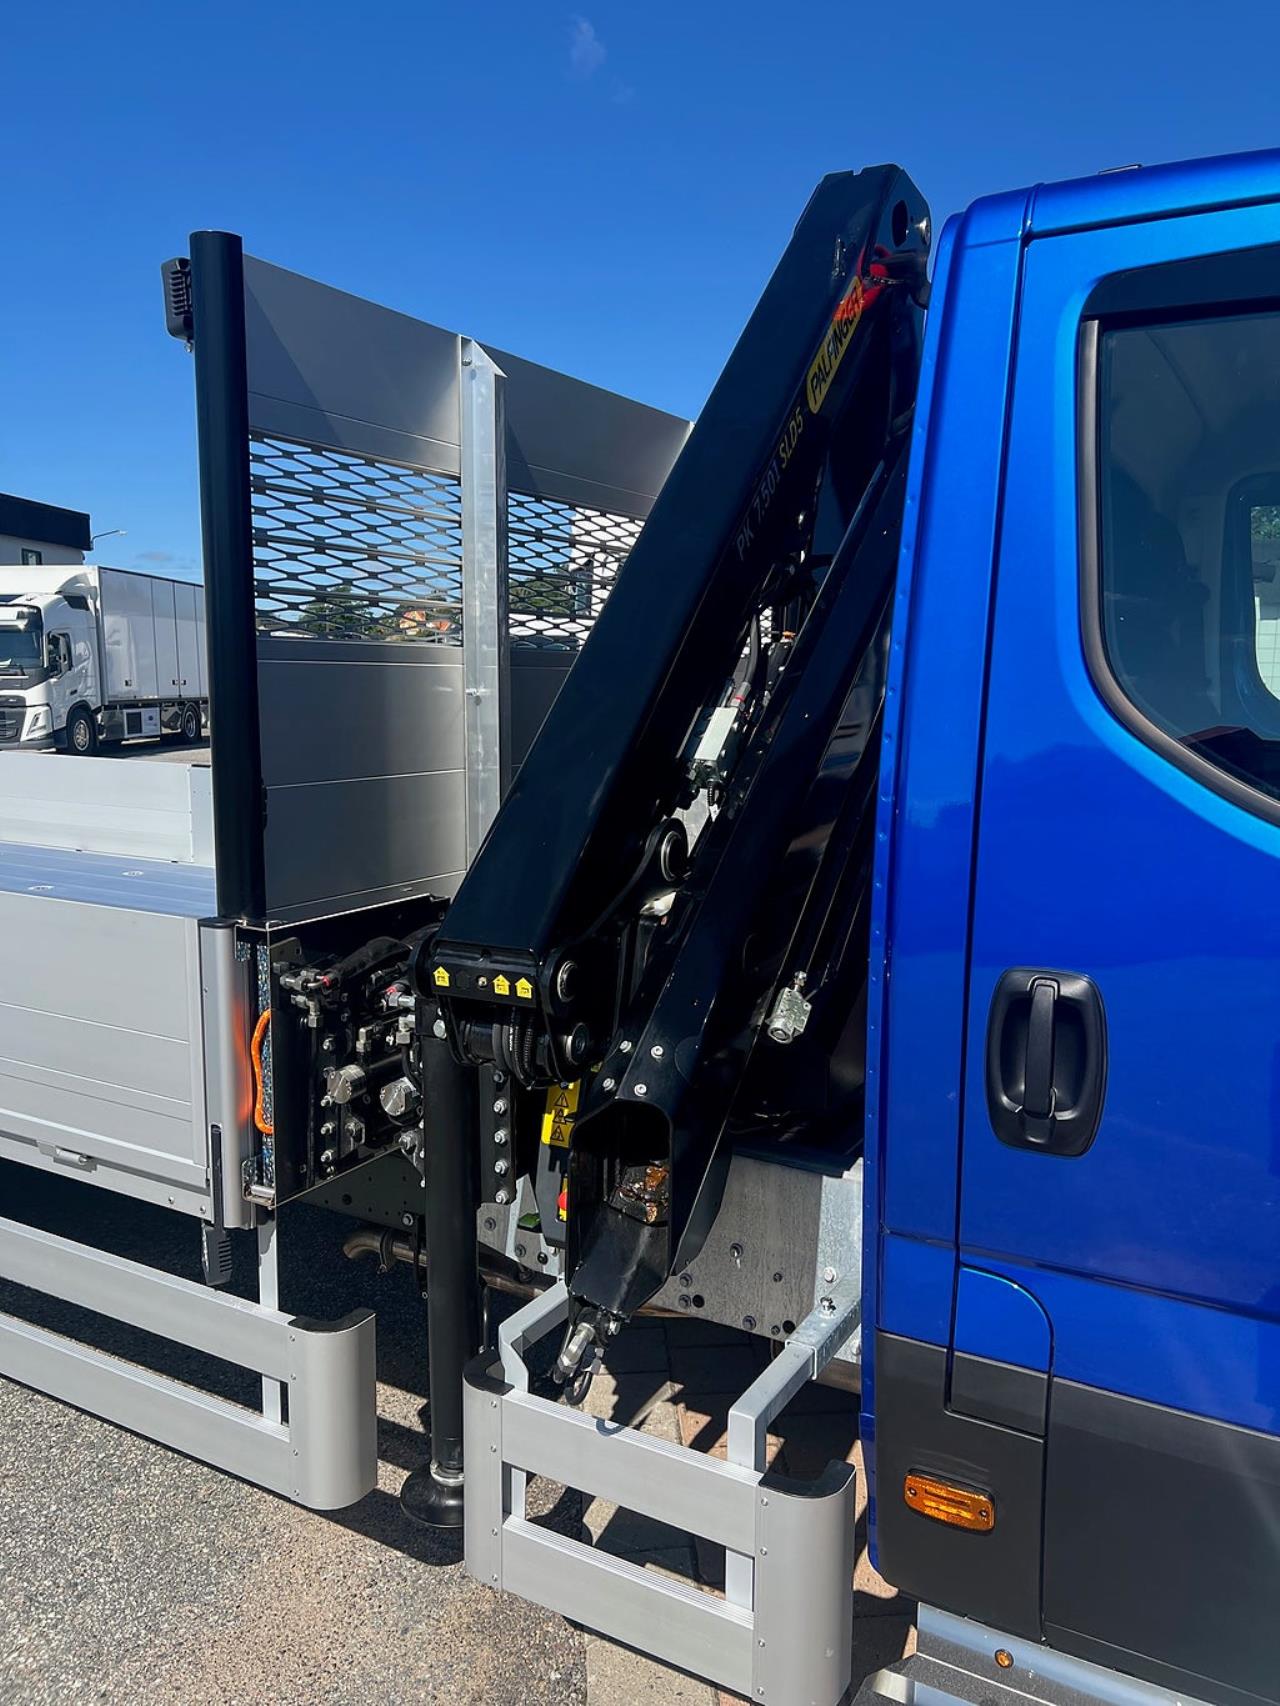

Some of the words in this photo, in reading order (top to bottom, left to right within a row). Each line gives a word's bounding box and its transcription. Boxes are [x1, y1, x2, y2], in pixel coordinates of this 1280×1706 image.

[810, 284, 862, 405] PALFINGER
[737, 516, 755, 561] PK
[753, 460, 780, 525] 7.501
[779, 405, 803, 469] SLD5
